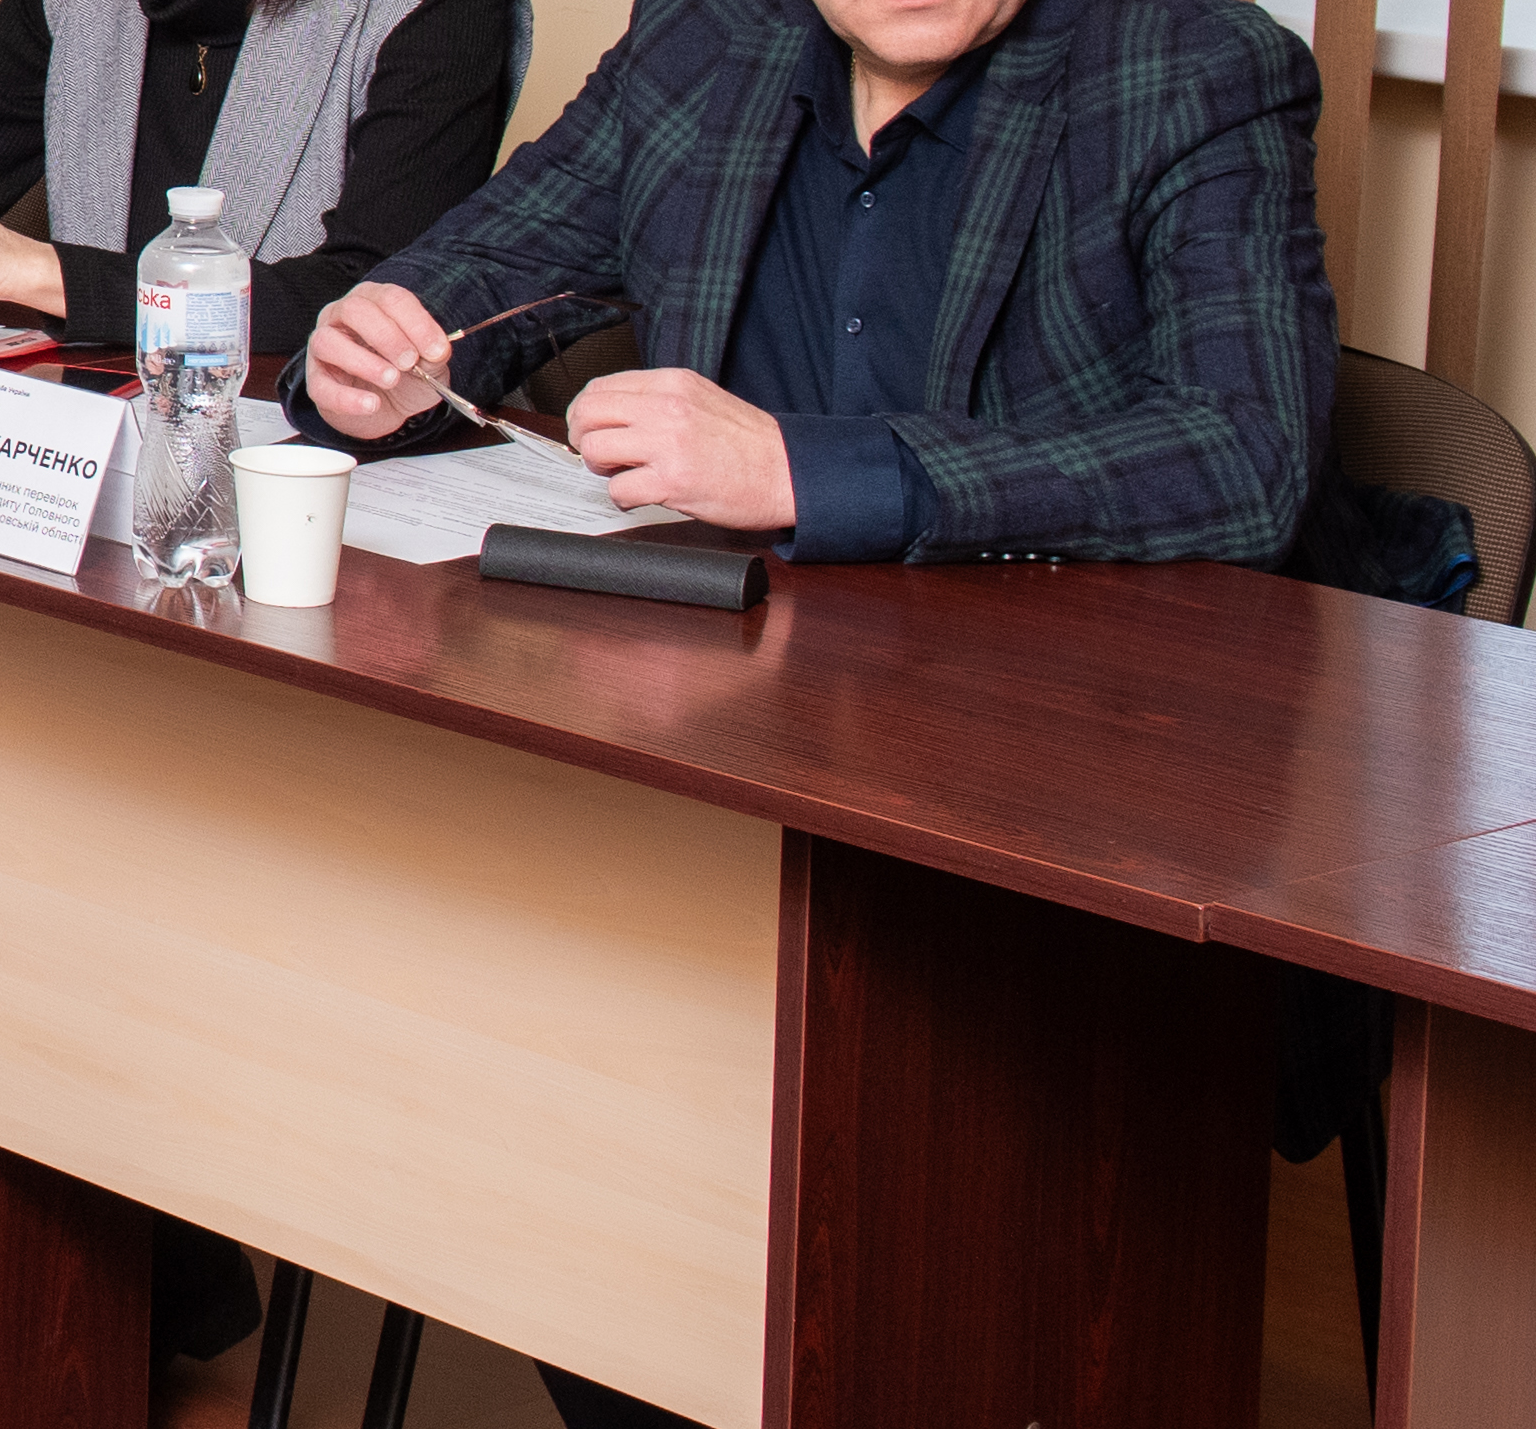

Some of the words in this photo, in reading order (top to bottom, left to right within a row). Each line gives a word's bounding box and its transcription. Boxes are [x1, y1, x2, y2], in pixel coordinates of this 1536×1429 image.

[23, 487, 78, 510] перевірок
[22, 502, 80, 527] Головного
[41, 526, 86, 547] області
